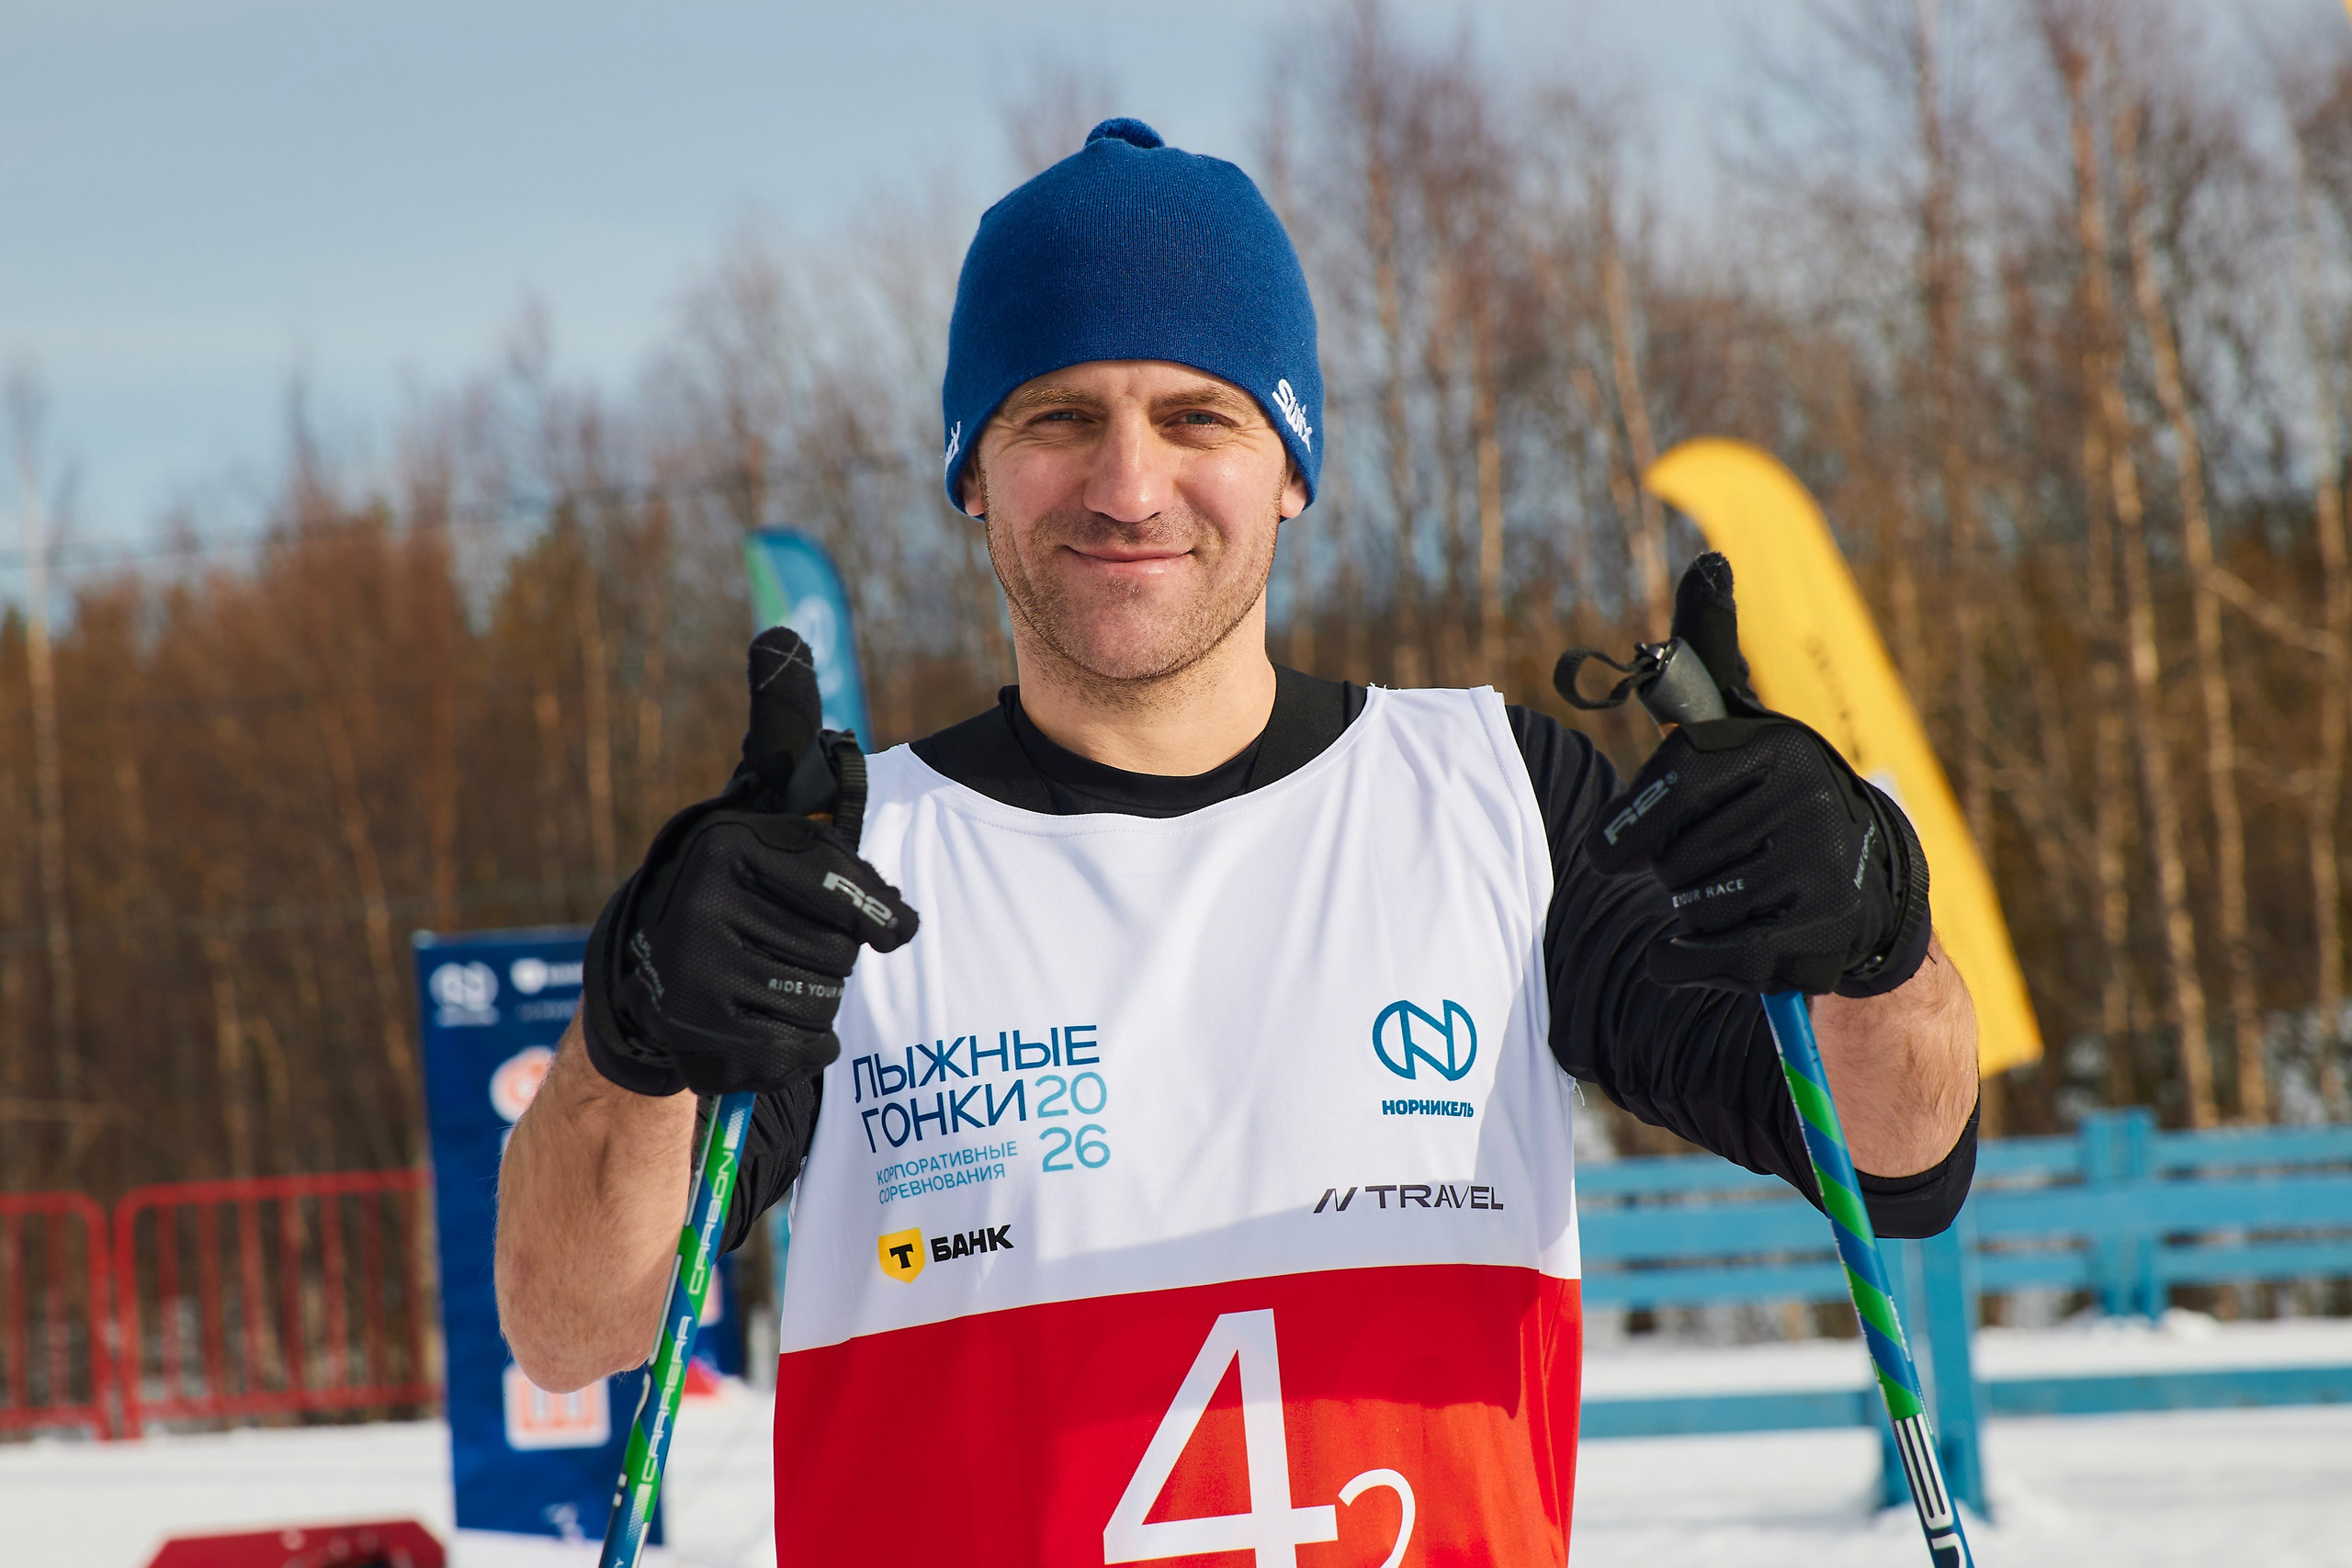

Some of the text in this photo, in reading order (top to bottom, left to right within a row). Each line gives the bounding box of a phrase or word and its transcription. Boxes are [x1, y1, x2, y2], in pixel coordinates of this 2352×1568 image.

[1272, 378, 1312, 454] Swix
[1706, 878, 1745, 898] RACE
[768, 978, 803, 995] RIDE
[853, 1024, 1100, 1103] ЛЫЖНЫЕ
[861, 1079, 1027, 1153] ГОНКИ
[1382, 1100, 1475, 1117] НОРНИКЕЛЬ
[876, 1141, 1018, 1185] КОРПОРАТИВНЫЕ
[879, 1163, 1006, 1204] СОРЕВНОВАНИЯ
[1365, 1184, 1504, 1210] TRAVEL
[689, 1150, 735, 1295] CARBON
[930, 1224, 1014, 1263] БАНК
[641, 1315, 693, 1483] CARRERA
